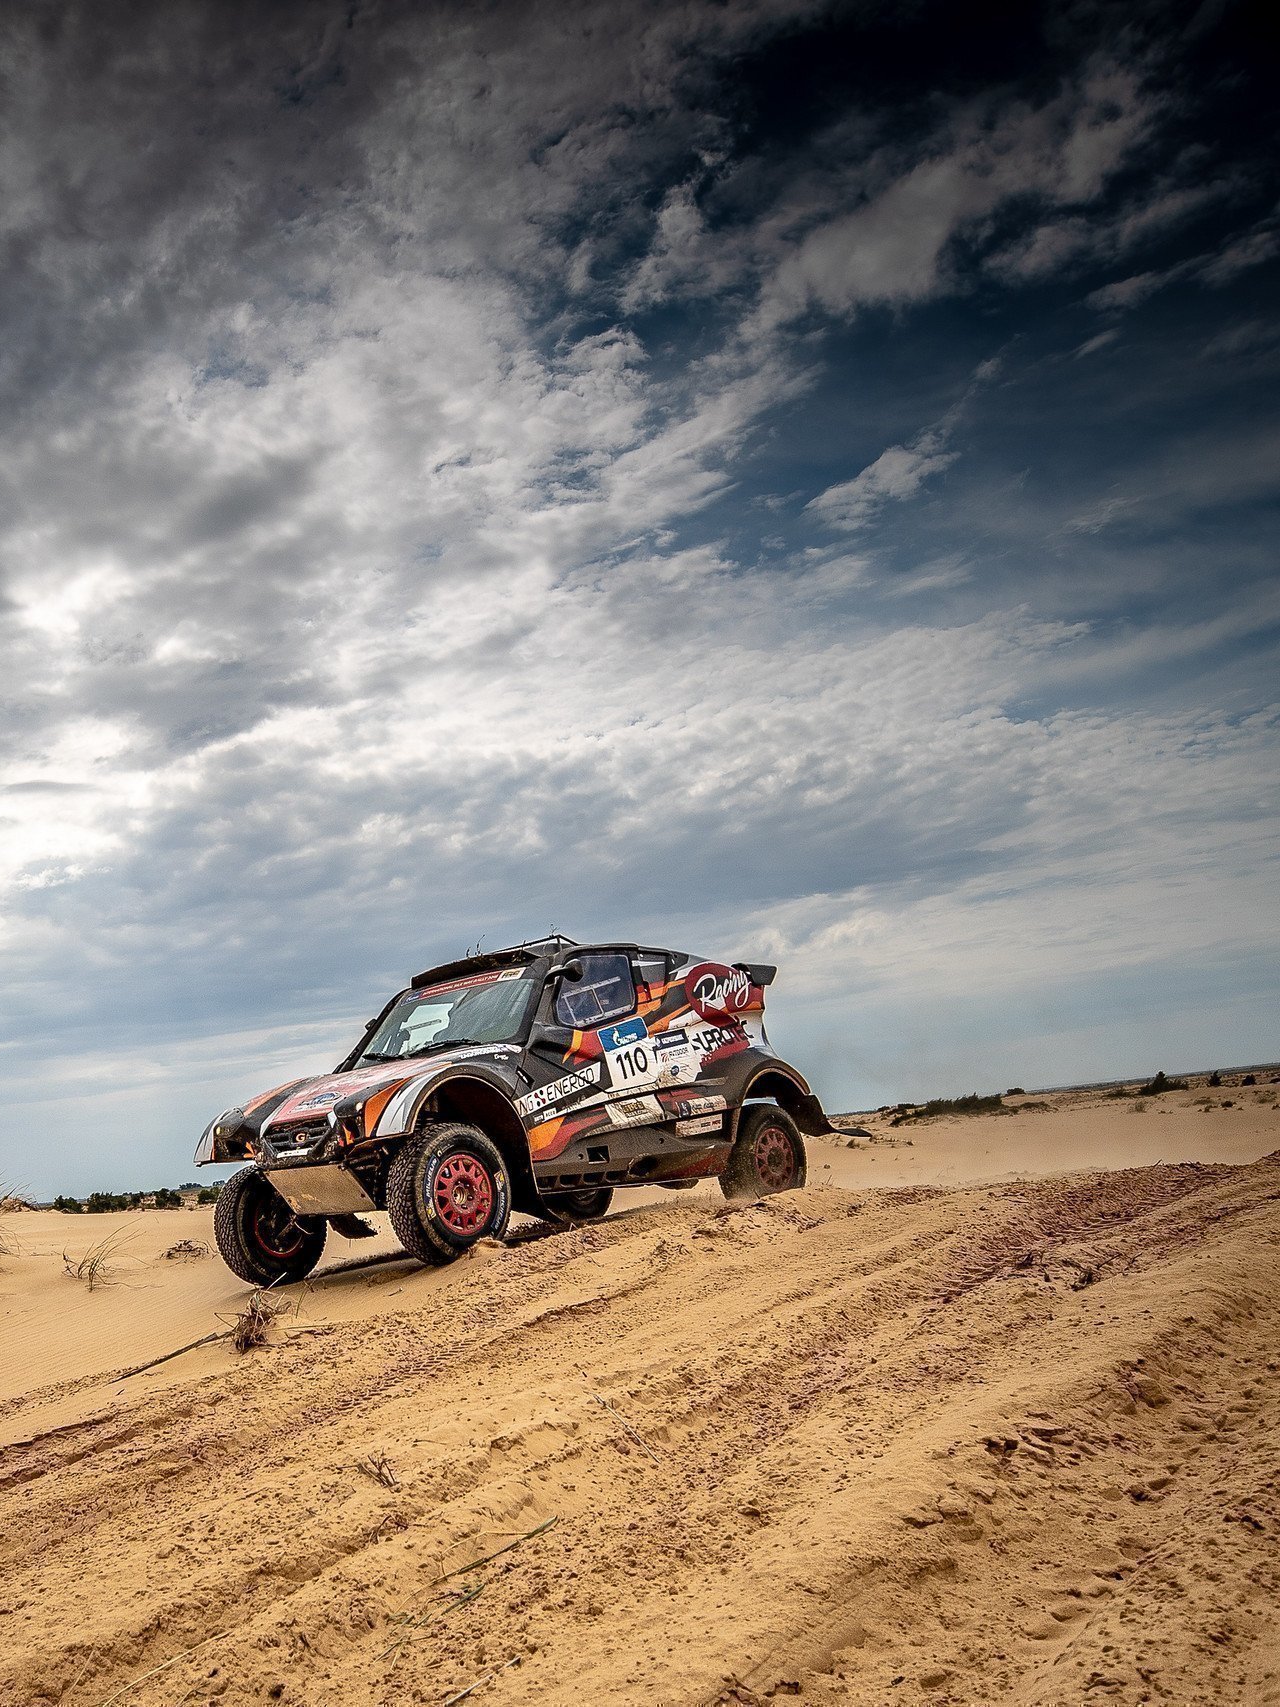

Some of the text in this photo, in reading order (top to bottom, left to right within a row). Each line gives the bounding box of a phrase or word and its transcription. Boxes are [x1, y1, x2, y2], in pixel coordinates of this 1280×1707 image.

[693, 970, 752, 1013] Racing
[691, 1019, 754, 1052] SUPROTEC
[616, 1047, 648, 1080] 110
[520, 1094, 534, 1118] NG
[546, 1068, 595, 1102] ENERGO
